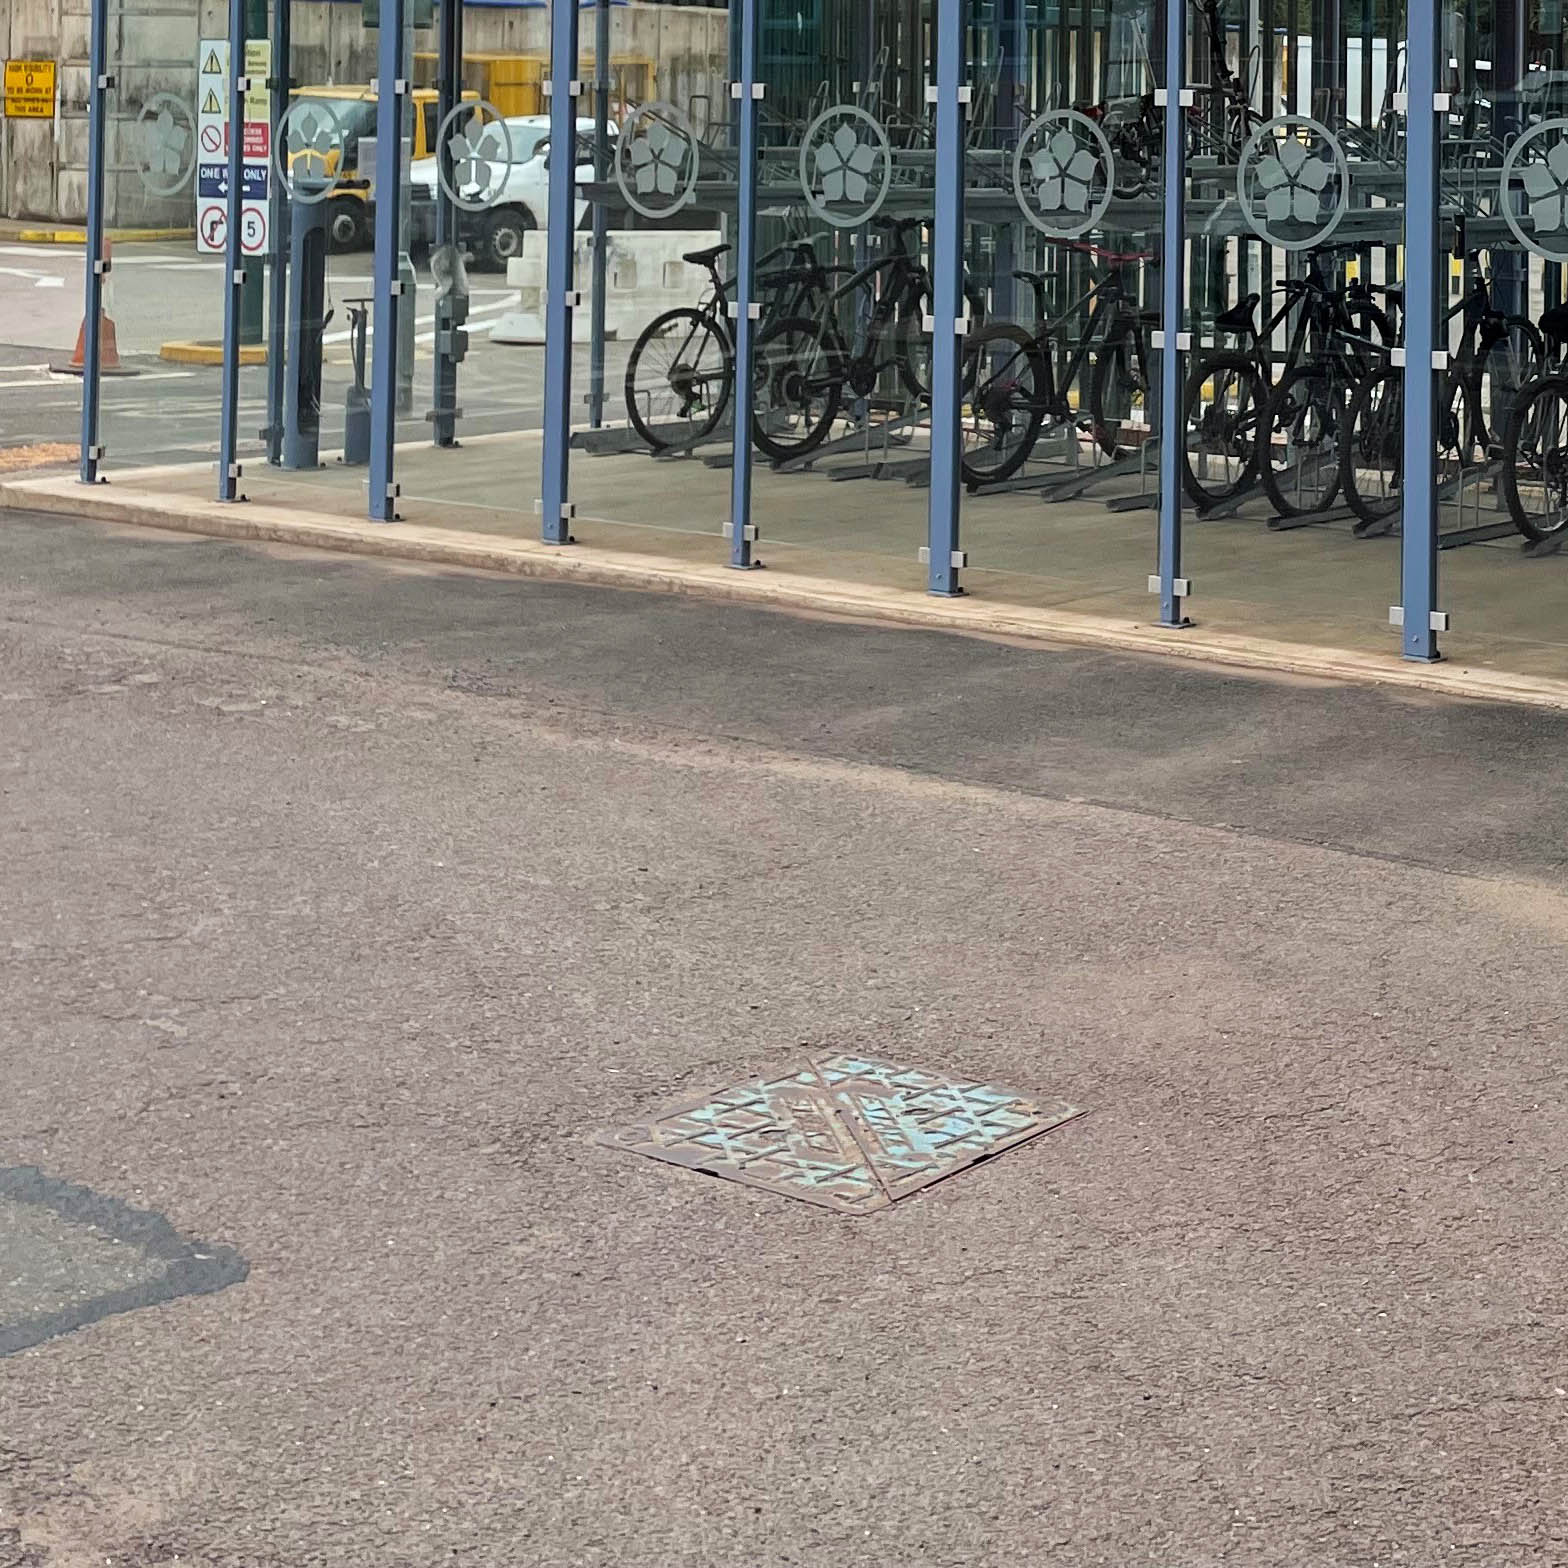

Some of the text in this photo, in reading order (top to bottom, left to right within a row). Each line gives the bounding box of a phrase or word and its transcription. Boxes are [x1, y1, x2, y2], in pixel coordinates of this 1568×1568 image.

[200, 167, 221, 180] ONE
[243, 167, 267, 181] ONLY
[247, 220, 256, 238] 5
